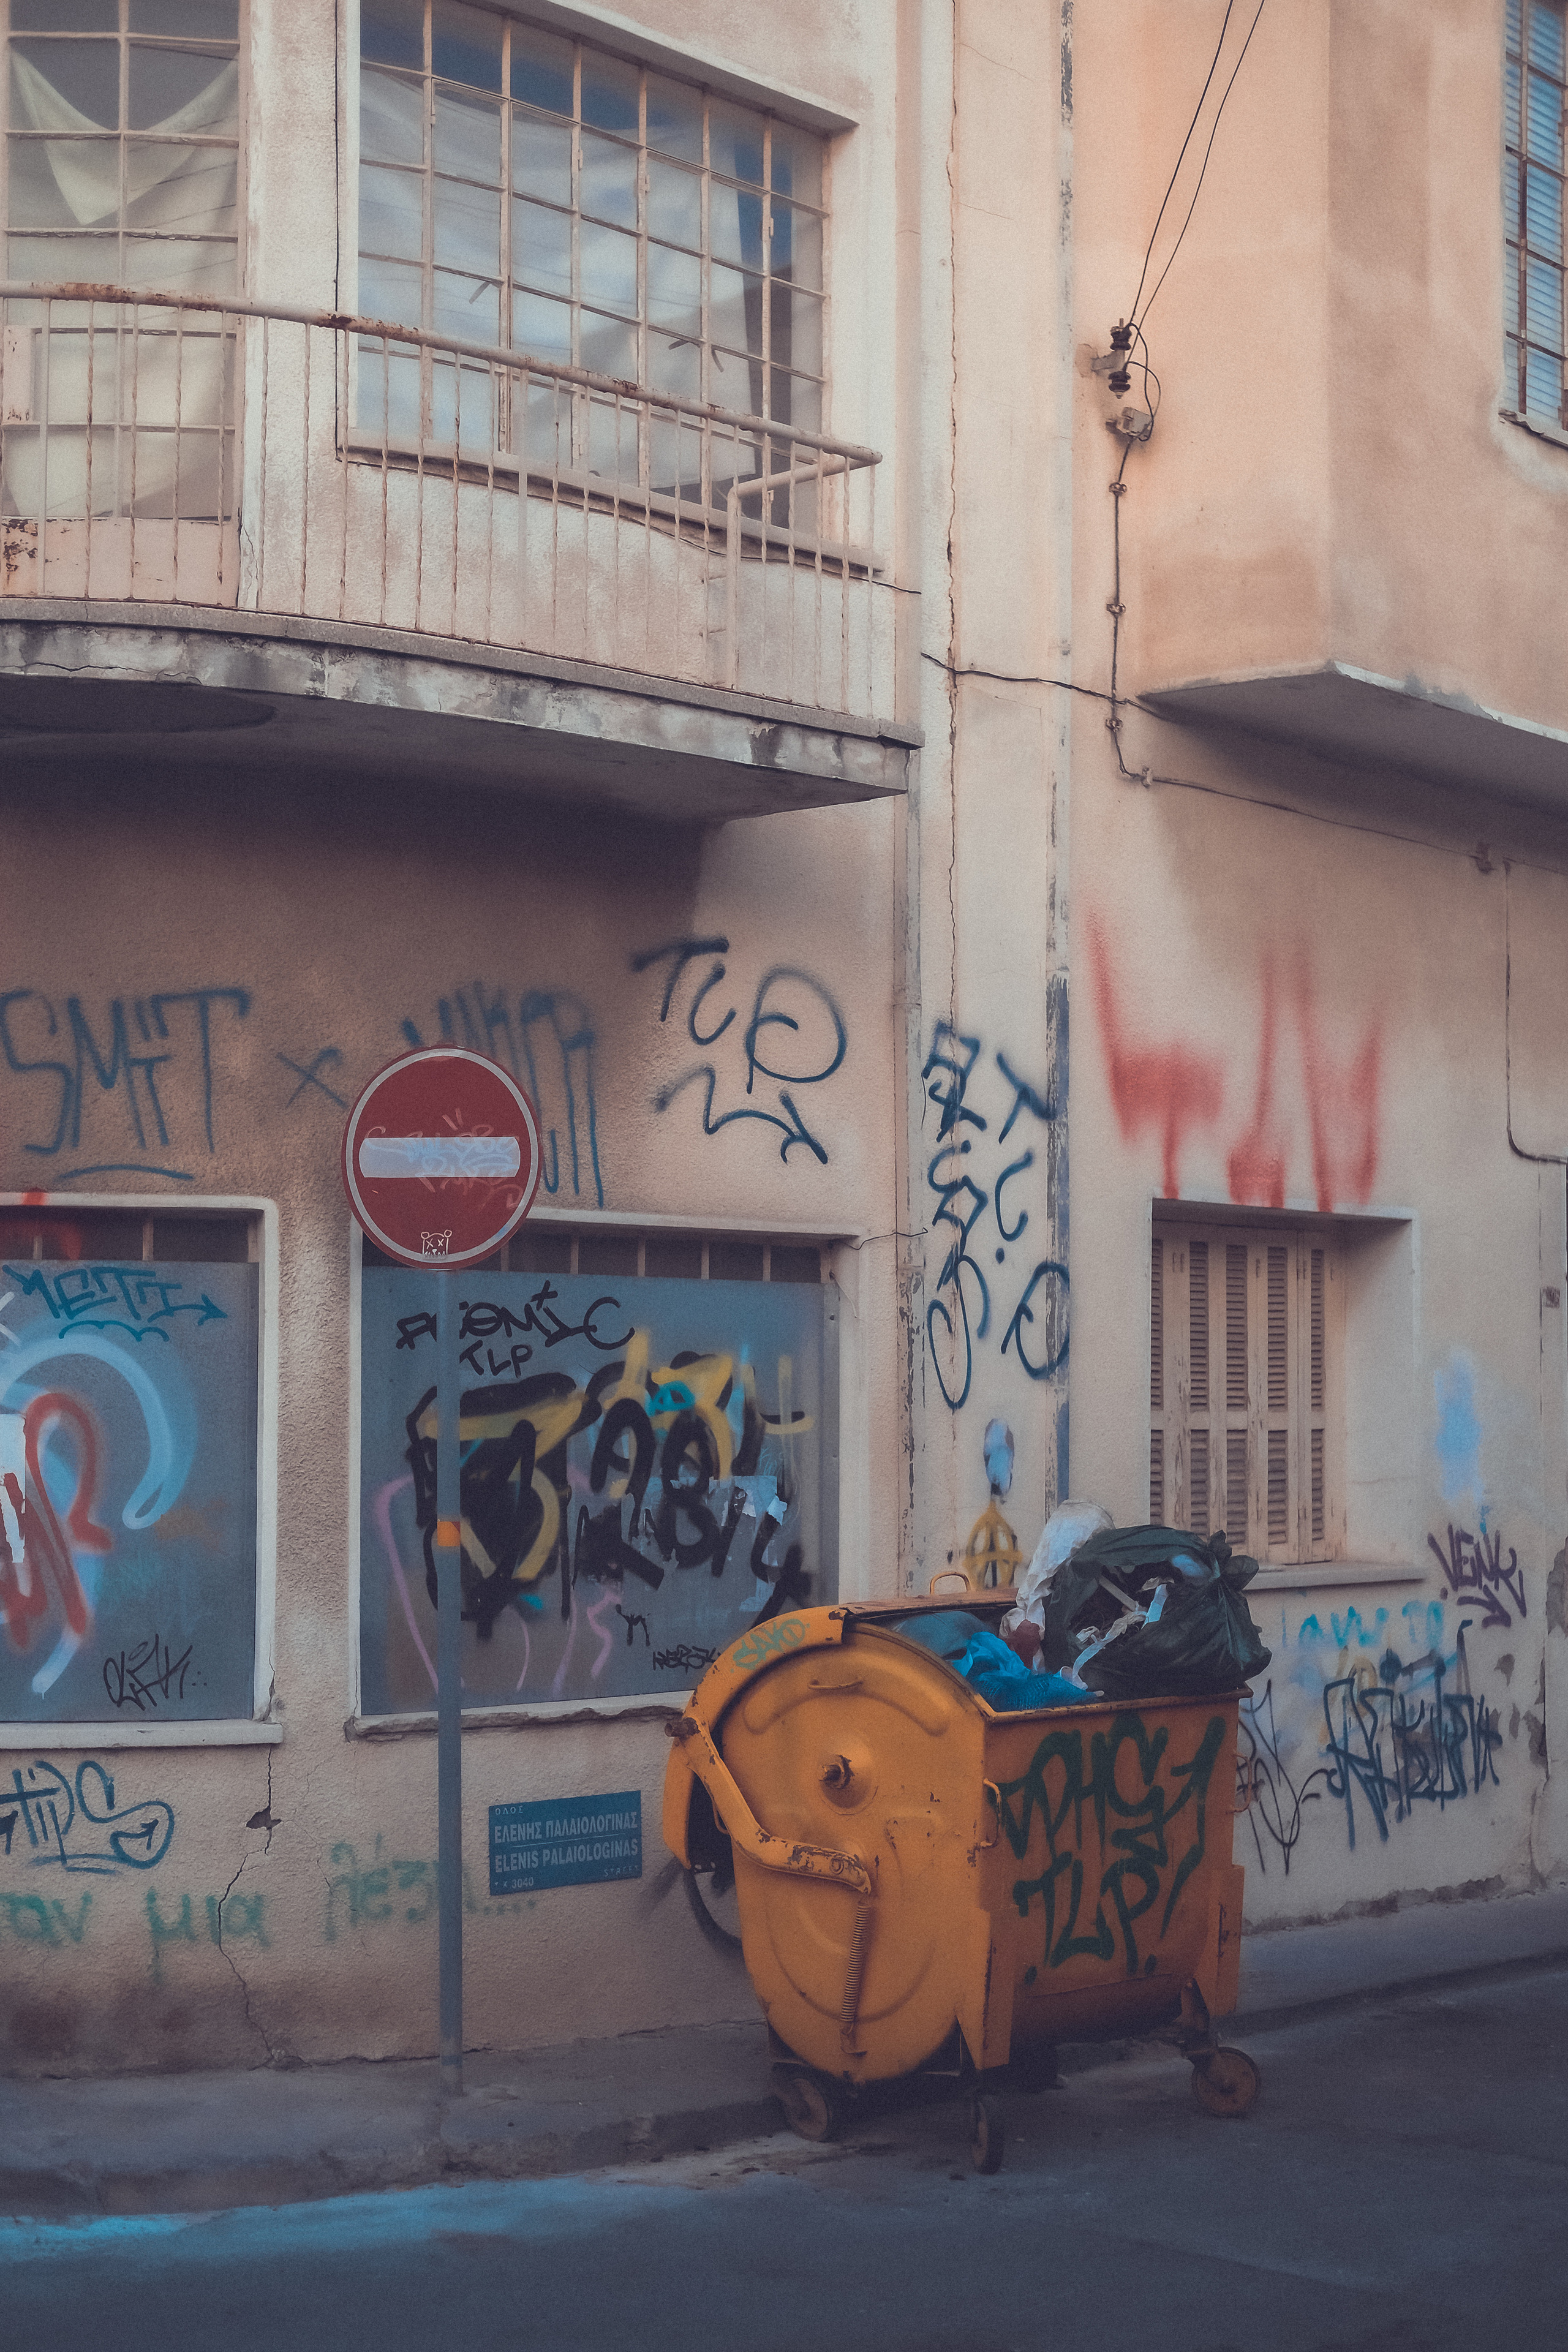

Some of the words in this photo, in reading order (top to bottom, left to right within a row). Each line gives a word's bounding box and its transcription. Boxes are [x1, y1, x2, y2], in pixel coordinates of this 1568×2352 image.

[494, 1821, 542, 1844] ΕΛΕΝΗΣ
[546, 1811, 638, 1838] ΠΑΛΑΙΟΛΟΓΙΝΑΣ
[495, 1850, 538, 1873] ELENIS
[543, 1838, 638, 1867] PALAIOLOGINAS
[603, 1864, 639, 1877] STREET
[511, 1876, 534, 1889] 3040
